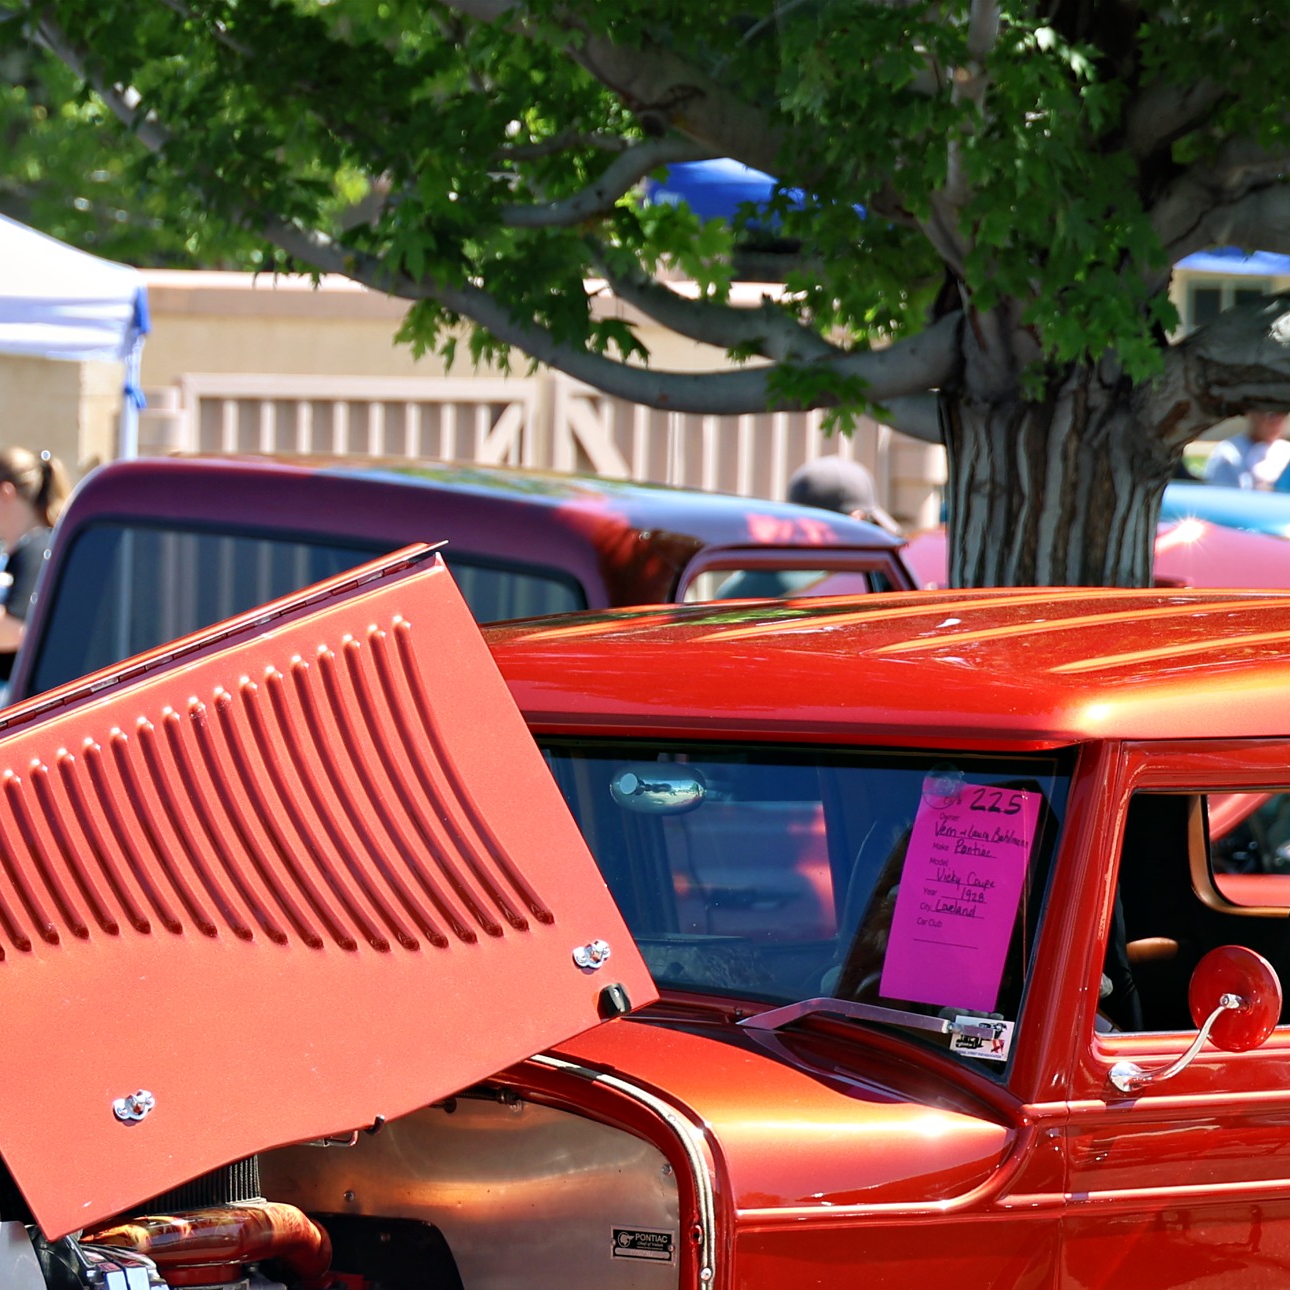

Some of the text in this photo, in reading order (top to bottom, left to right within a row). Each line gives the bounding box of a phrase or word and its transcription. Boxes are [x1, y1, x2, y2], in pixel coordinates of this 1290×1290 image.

[970, 788, 1023, 815] 225
[954, 840, 991, 857] Pontiac
[967, 871, 996, 891] Coupe
[923, 887, 985, 903] Year 1928
[919, 902, 931, 912] City
[916, 917, 943, 928] Car Club
[635, 1233, 668, 1243] PONTIAC
